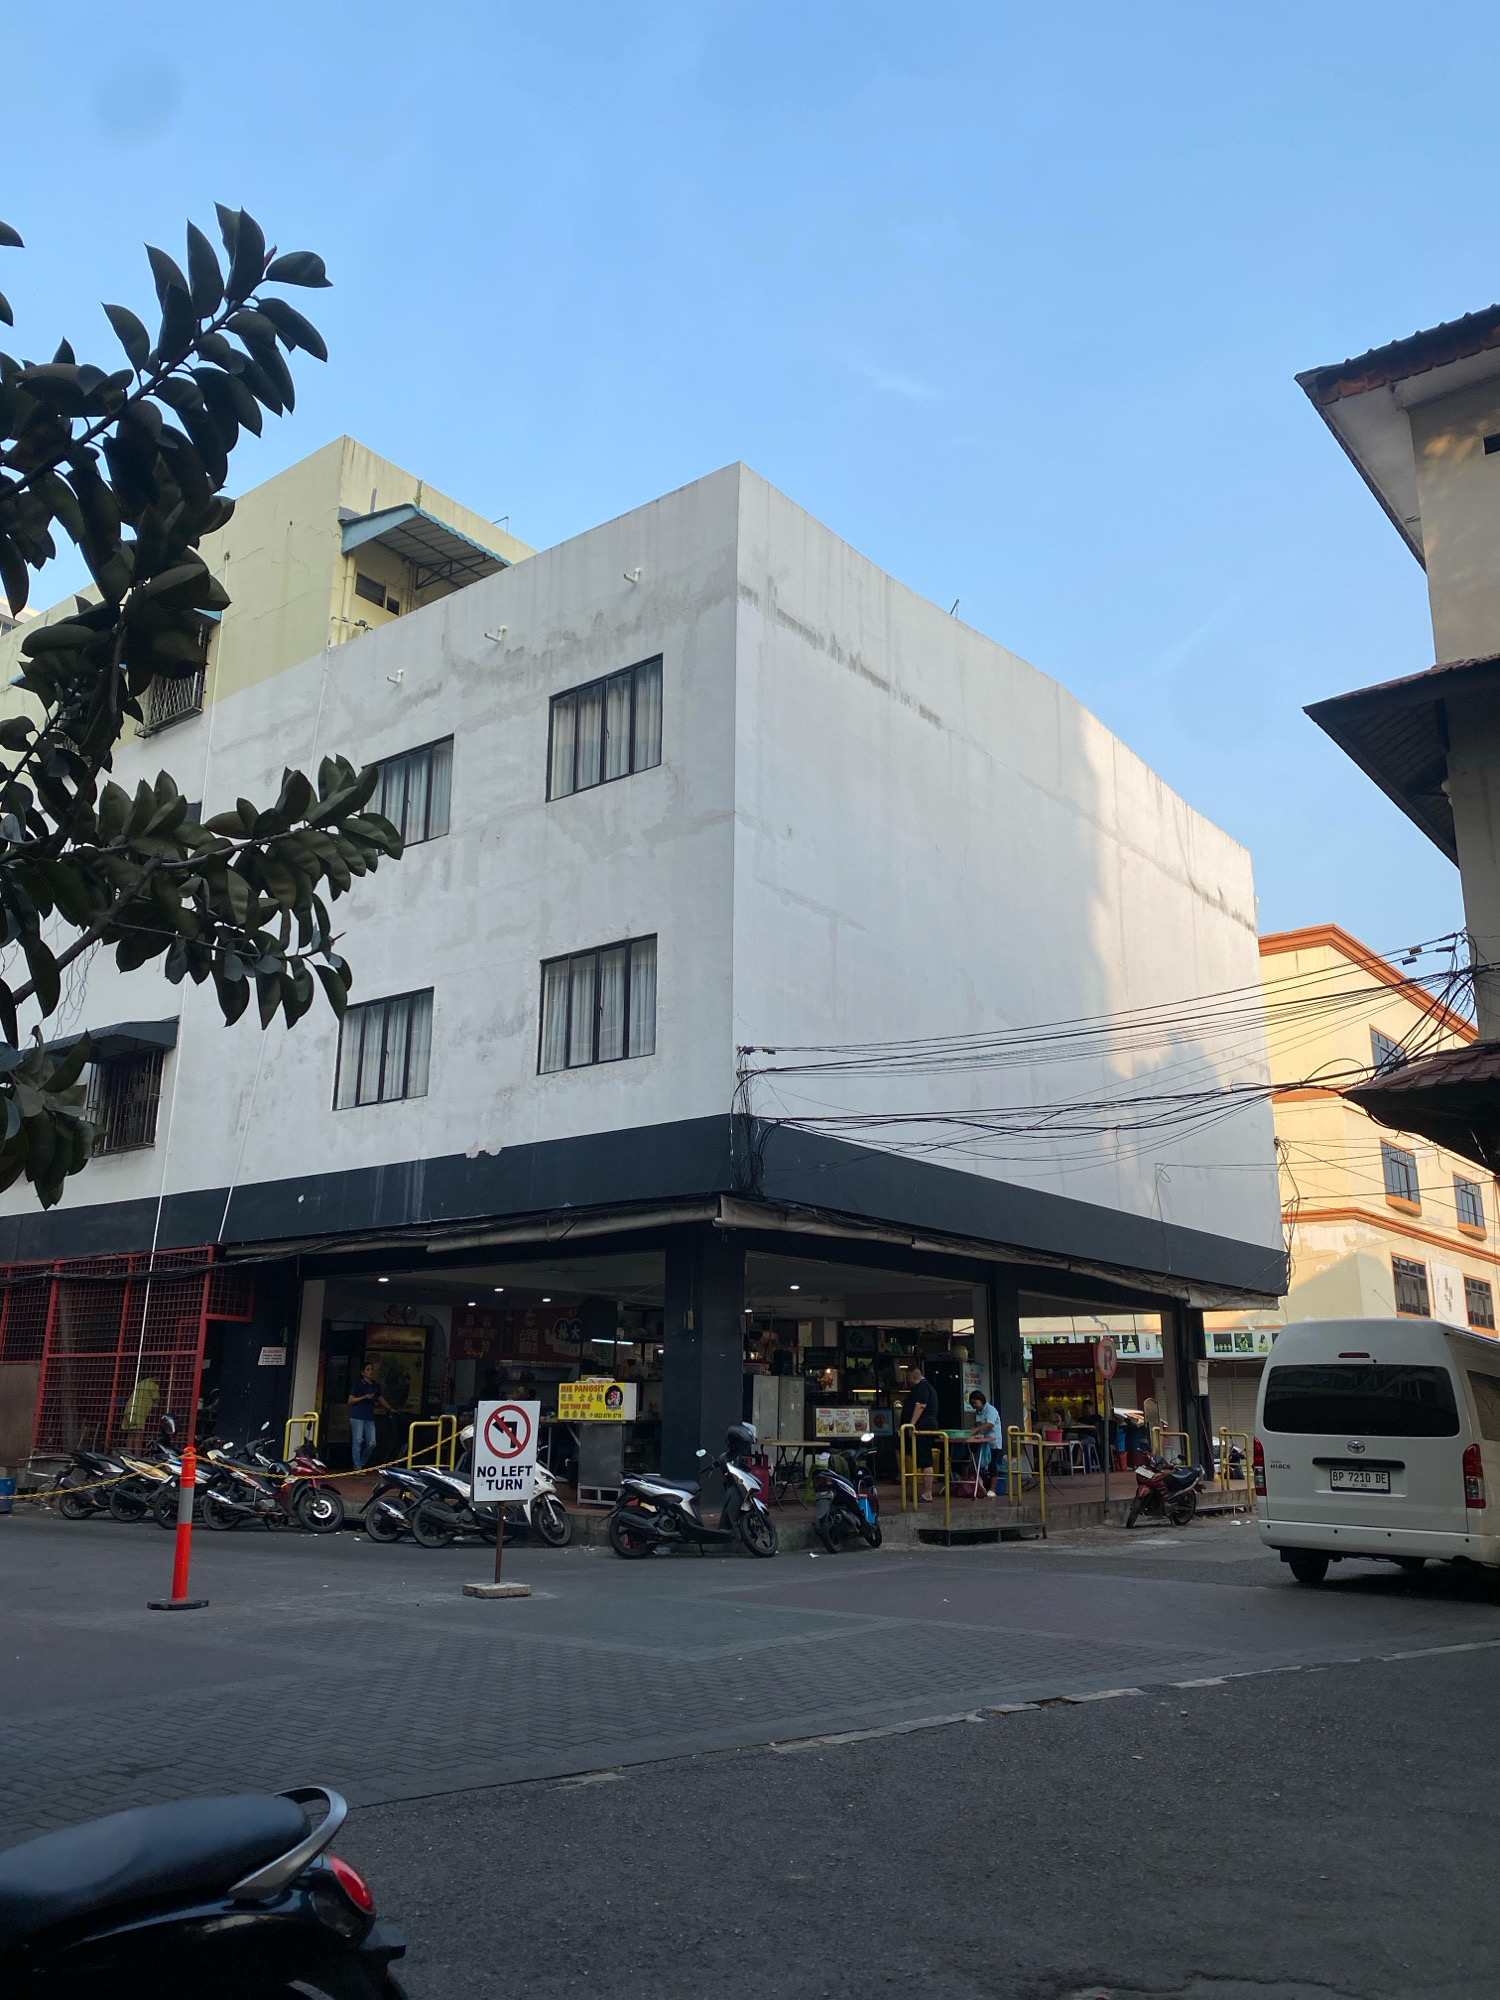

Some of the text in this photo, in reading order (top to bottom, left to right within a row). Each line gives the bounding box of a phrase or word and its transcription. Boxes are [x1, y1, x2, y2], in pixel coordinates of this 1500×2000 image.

[476, 1465, 533, 1478] NO LEFT
[1332, 1471, 1387, 1484] BP 7210 DE
[486, 1478, 523, 1491] TURN
